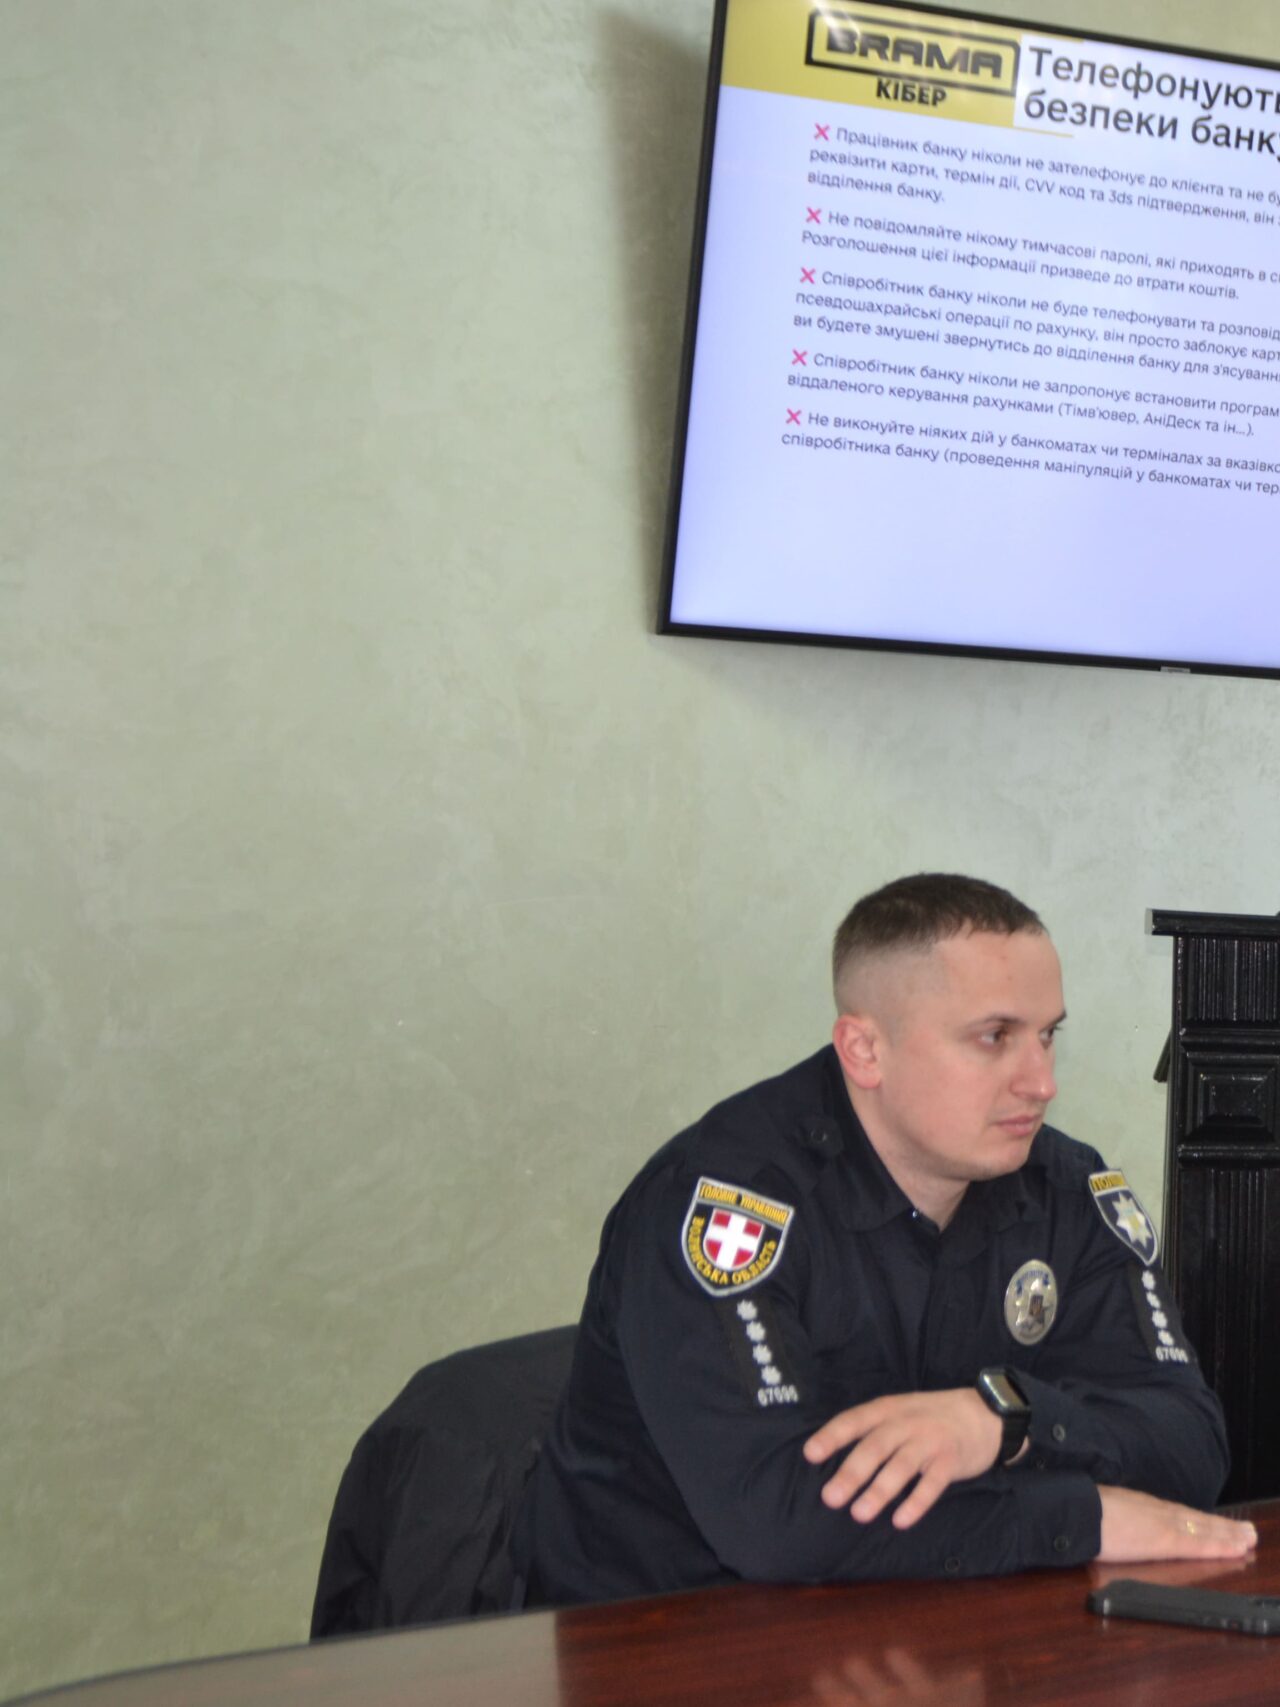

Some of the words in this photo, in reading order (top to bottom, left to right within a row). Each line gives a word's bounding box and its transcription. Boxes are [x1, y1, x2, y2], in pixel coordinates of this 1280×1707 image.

[826, 27, 1003, 79] BRAMA
[876, 77, 947, 107] КІБЕР
[1023, 88, 1179, 140] безпеки
[806, 170, 893, 194] відділення
[896, 181, 945, 204] банку.
[808, 148, 887, 171] реквізити
[889, 160, 939, 180] карти,
[943, 167, 996, 186] термін
[997, 175, 1021, 191] дії,
[1024, 177, 1056, 195] CVV
[1058, 184, 1086, 201] код
[1089, 188, 1105, 202] та
[1107, 188, 1134, 206] 3ds
[1136, 195, 1249, 223] підтвердження,
[1252, 211, 1275, 225] він
[835, 126, 919, 153] Працівник
[921, 140, 968, 163] банку
[970, 150, 1022, 167] ніколи
[1024, 157, 1045, 171] не
[1047, 160, 1146, 187] зателефонує
[1147, 174, 1168, 189] до
[1170, 178, 1225, 197] клієнта
[1227, 186, 1243, 200] та
[1245, 189, 1265, 203] не
[800, 229, 918, 258] Розголошення
[920, 247, 949, 263] цієї
[951, 250, 1036, 275] інформації
[1039, 262, 1111, 284] призведе
[1112, 273, 1133, 287] до
[1135, 275, 1185, 293] втрати
[1187, 282, 1239, 300] коштів.
[827, 210, 851, 227] Не
[852, 215, 963, 242] повідомляйте
[965, 231, 1018, 252] нікому
[1021, 238, 1096, 259] тимчасові
[1099, 249, 1152, 269] паролі,
[1155, 256, 1176, 270] які
[1178, 259, 1255, 281] приходять
[1257, 269, 1267, 282] в
[794, 291, 942, 321] псевдошахрайські
[944, 310, 1011, 330] операції
[1012, 318, 1033, 333] по
[1035, 321, 1099, 343] рахунку,
[1102, 328, 1125, 344] він
[1127, 332, 1181, 350] просто
[1182, 338, 1248, 359] заблокує
[820, 270, 925, 297] Співробітник
[927, 283, 974, 306] банку
[975, 291, 1027, 310] ніколи
[1030, 299, 1050, 313] не
[1052, 299, 1089, 318] буде
[1092, 306, 1197, 330] телефонувати
[1199, 319, 1215, 333] та
[792, 314, 813, 328] ви
[815, 314, 872, 336] будете
[873, 323, 940, 343] змушені
[942, 331, 1031, 354] звернутись
[1032, 342, 1053, 357] до
[1055, 345, 1135, 366] відділення
[1137, 353, 1181, 374] банку
[1181, 360, 1210, 374] для
[786, 373, 885, 397] віддаленого
[887, 385, 970, 405] керування
[971, 394, 1054, 414] рахунками
[1142, 411, 1202, 431] АніДеск
[1204, 419, 1220, 433] та
[812, 352, 916, 377] Співробітник
[918, 364, 965, 386] банку
[967, 371, 1019, 389] ніколи
[1021, 378, 1041, 392] не
[1043, 380, 1131, 403] запропонує
[1133, 390, 1217, 411] встановити
[780, 432, 892, 456] співробітника
[894, 442, 940, 463] банку
[942, 447, 1041, 470] (проведення
[1043, 460, 1133, 480] маніпуляцій
[1135, 469, 1146, 484] у
[1147, 468, 1232, 490] банкоматах
[1233, 479, 1253, 492] чи
[806, 411, 830, 428] Не
[832, 416, 915, 436] виконуйте
[918, 424, 968, 442] ніяких
[969, 429, 995, 445] дій
[996, 433, 1008, 449] у
[1009, 432, 1097, 455] банкоматах
[1100, 444, 1120, 457] чи
[1121, 446, 1203, 466] терміналах
[1205, 455, 1222, 468] за
